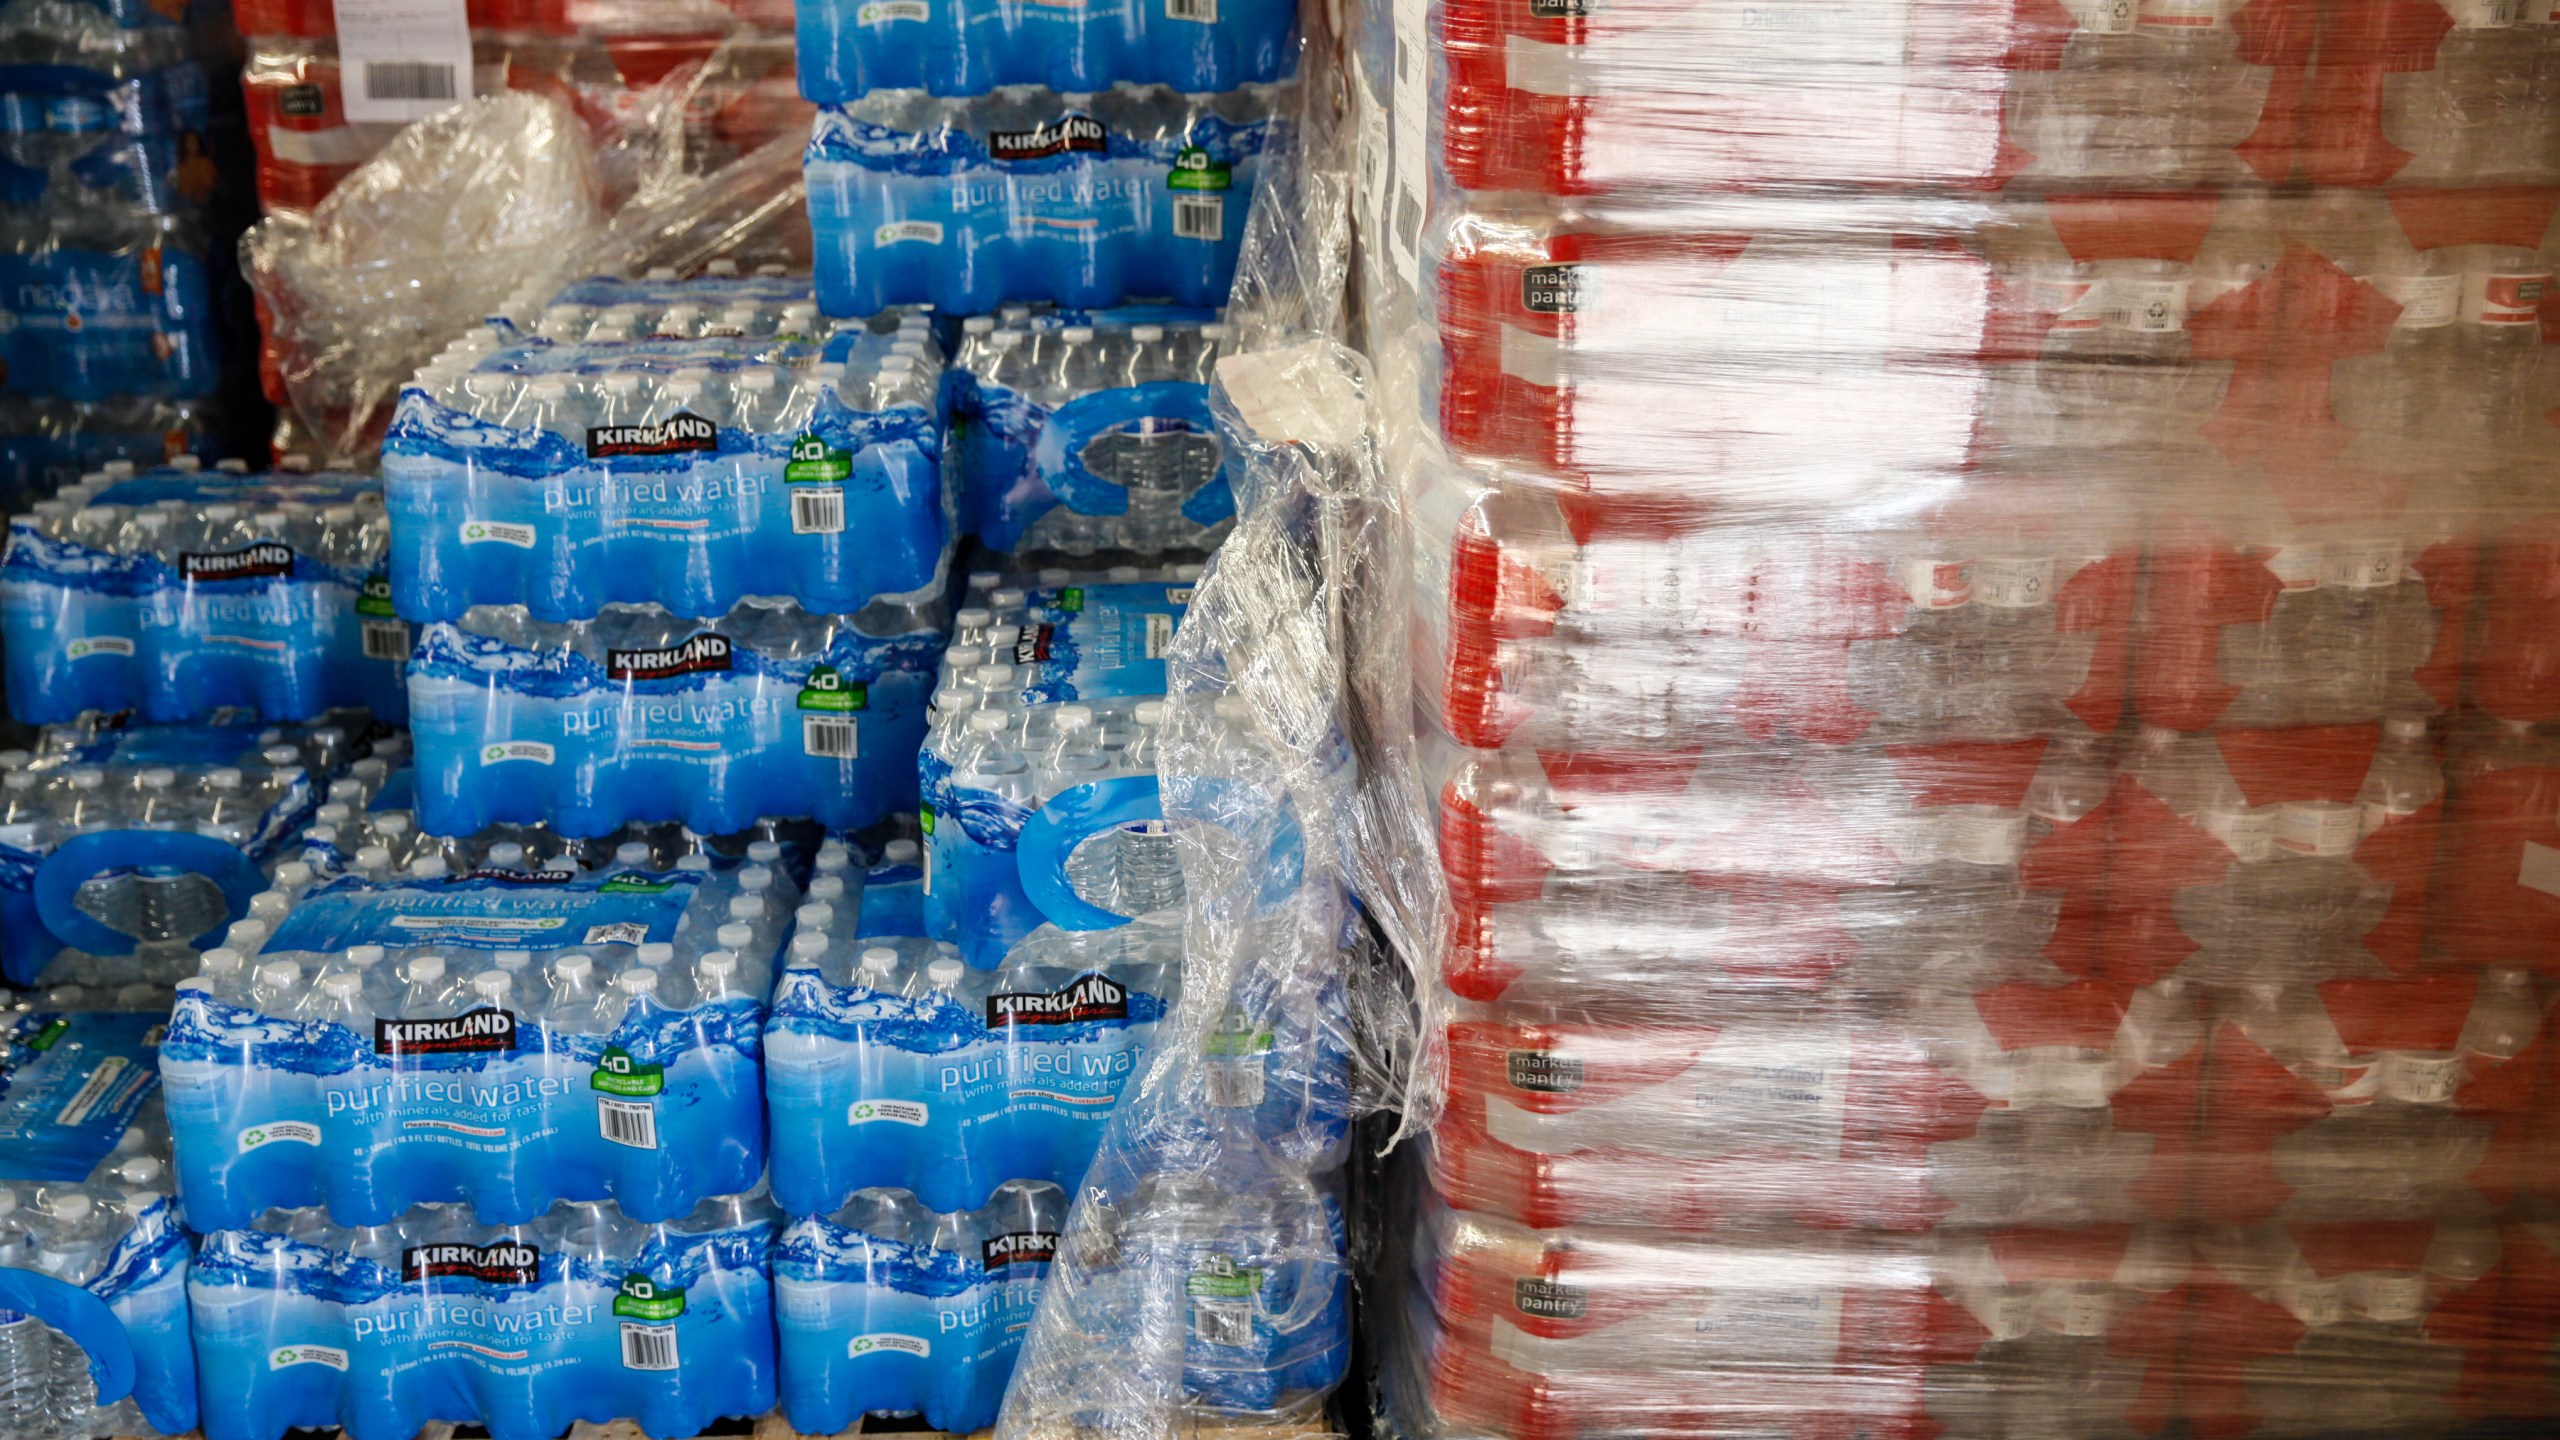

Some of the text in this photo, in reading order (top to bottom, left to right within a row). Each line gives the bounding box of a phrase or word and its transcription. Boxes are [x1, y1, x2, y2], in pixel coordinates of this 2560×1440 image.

[997, 121, 1102, 149] KIRKLAND
[1176, 152, 1208, 170] 40
[1070, 178, 1153, 202] water
[596, 419, 712, 445] KIRKLAND
[792, 442, 823, 461] 40
[543, 473, 771, 513] purified water
[186, 548, 290, 572] KIRKLAND
[615, 638, 727, 669] KIRKLAND
[807, 673, 839, 690] 40
[563, 694, 783, 736] purified water
[611, 873, 649, 887] 40
[376, 896, 502, 912] purified
[996, 980, 1121, 1013] KIRKLAND
[384, 1013, 511, 1041] KIRKLAND
[996, 1005, 1123, 1027] Signature
[384, 1037, 511, 1054] Signature
[600, 1055, 630, 1074] 40
[940, 1043, 1145, 1093] purified wat
[965, 1073, 1122, 1098] with minerals added for
[1516, 1071, 1574, 1088] pantry
[327, 1075, 575, 1118] purified water
[1010, 1091, 1037, 1099] Please
[1037, 1091, 1055, 1100] shop
[352, 1100, 553, 1127] with minerals added for taste
[405, 1121, 431, 1129] Please
[411, 1247, 535, 1268] KIRKLAND
[622, 1280, 653, 1299] 40
[939, 1283, 1042, 1335] purifie
[1522, 1296, 1578, 1315] pantry
[354, 1300, 599, 1342] purified water
[963, 1310, 1031, 1339] with miner
[380, 1333, 411, 1347] with
[414, 1328, 474, 1341] minerals
[514, 1334, 533, 1346] for
